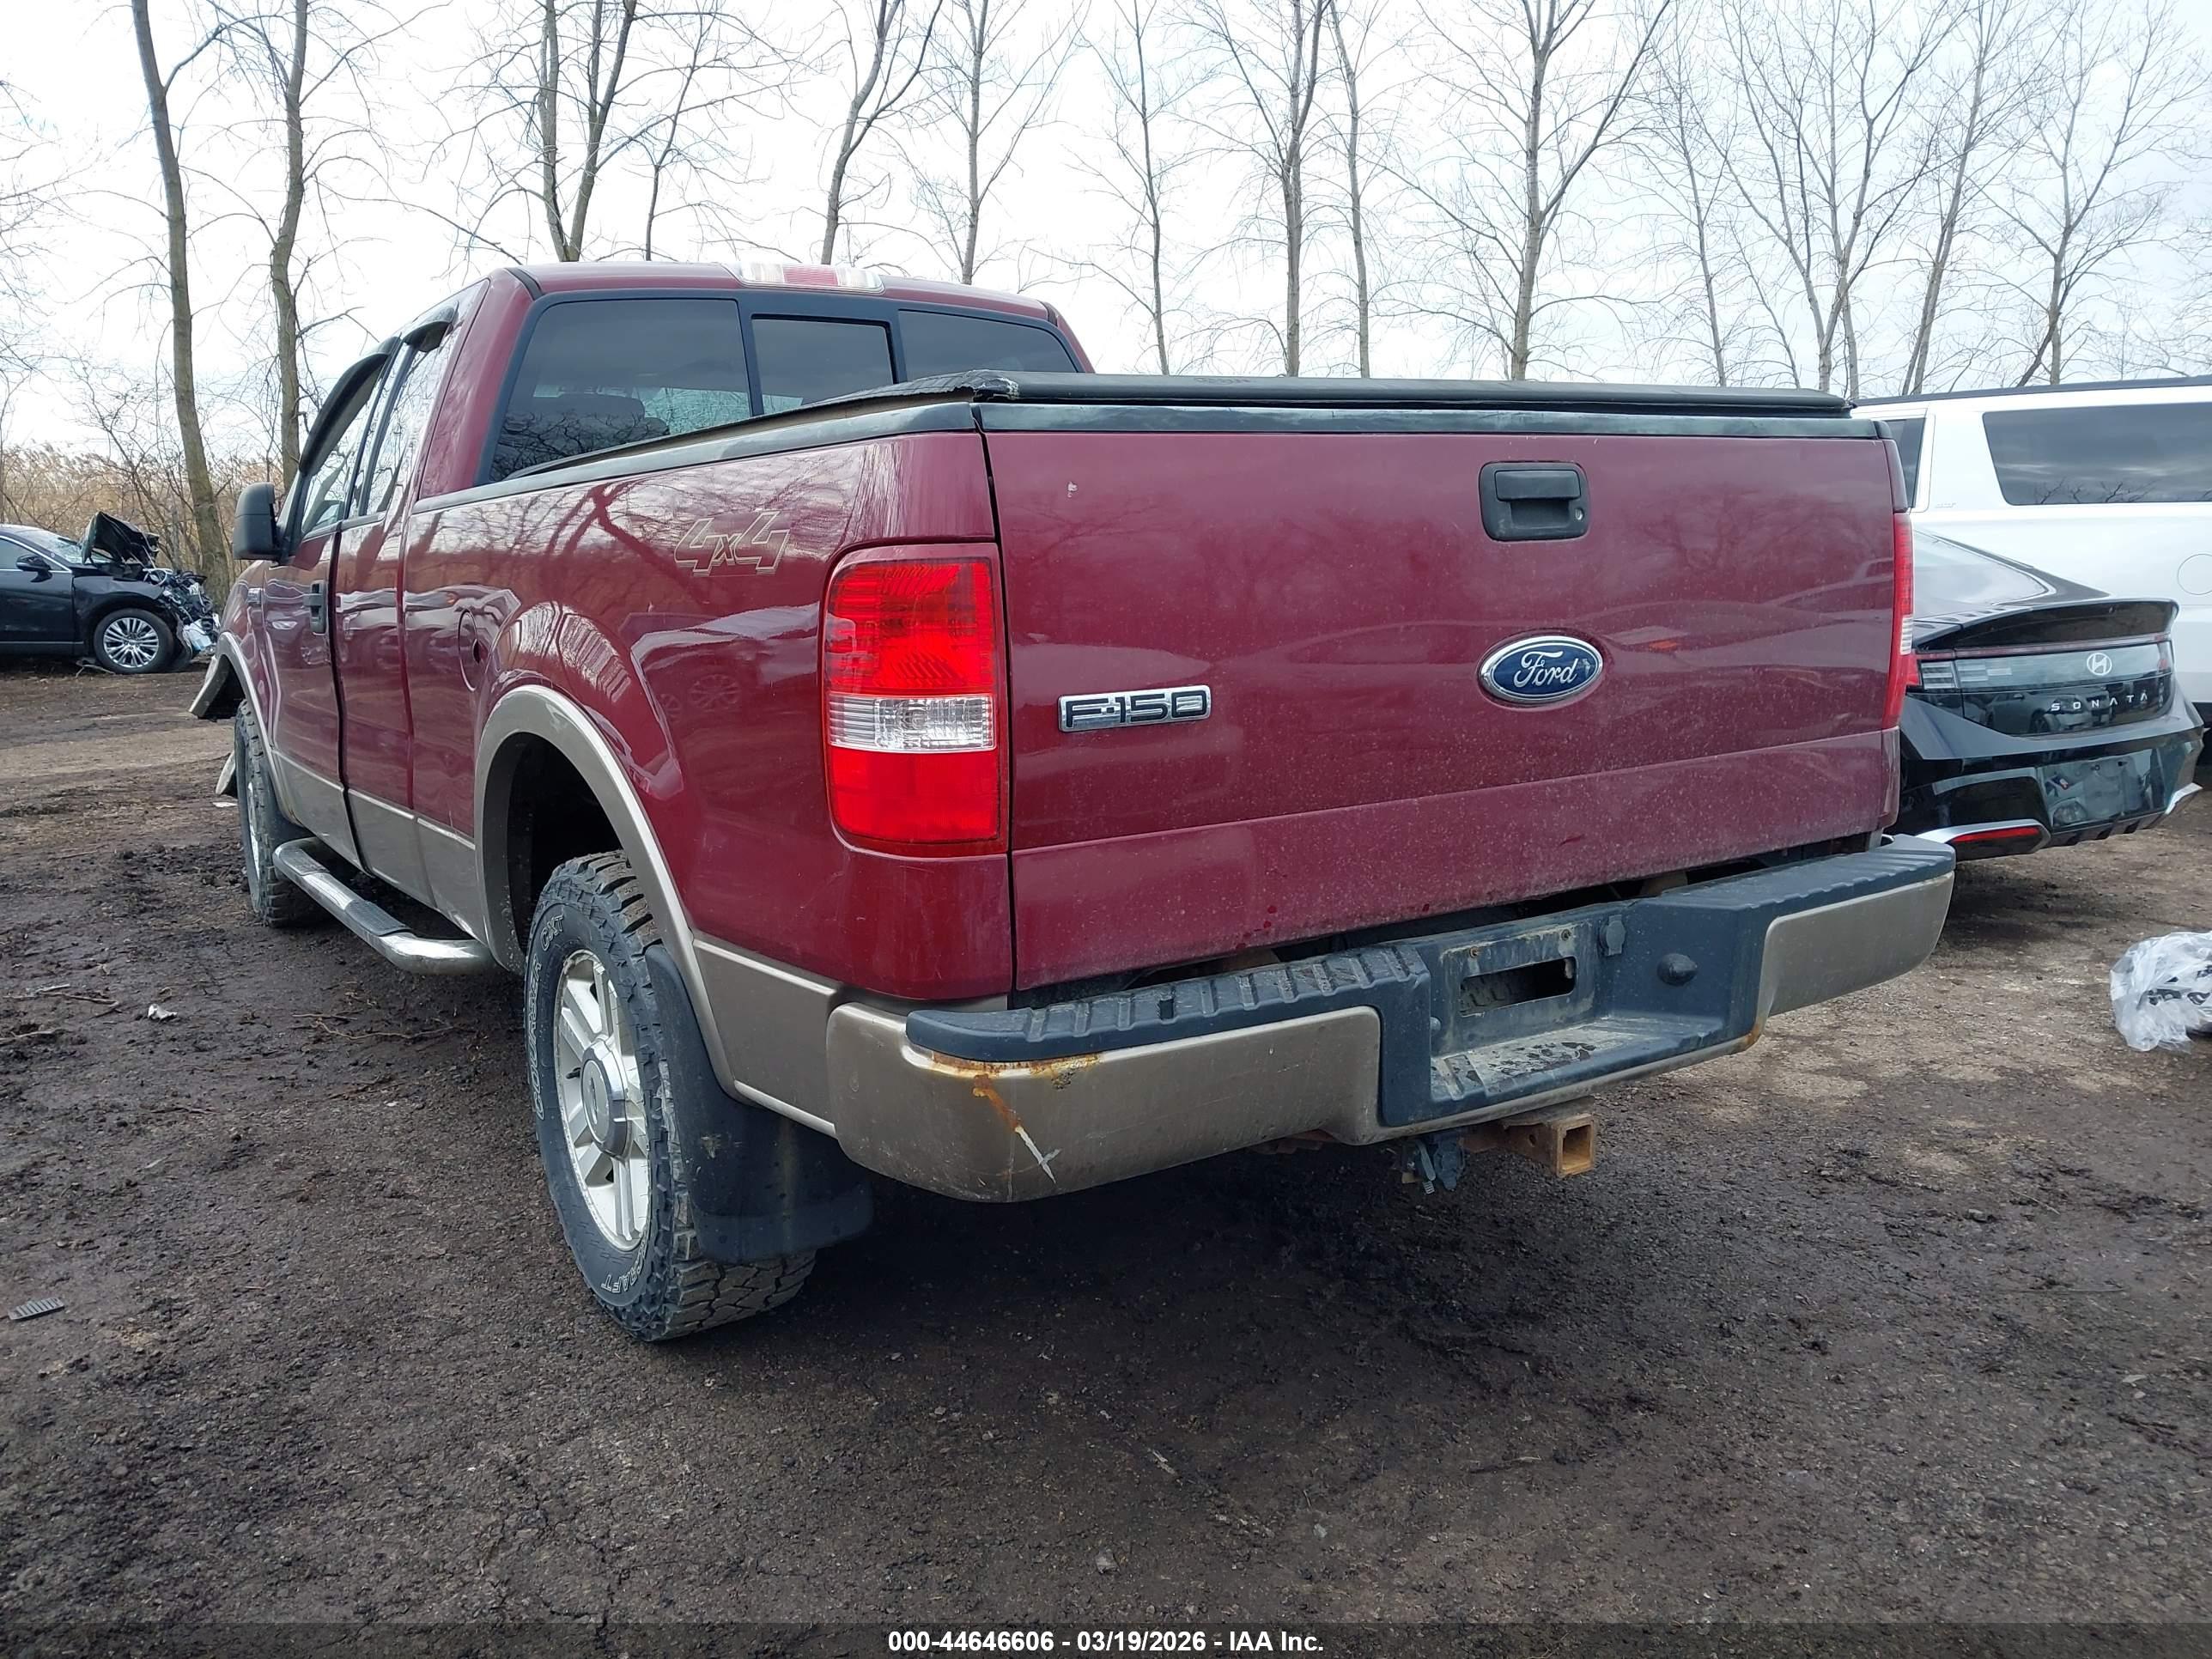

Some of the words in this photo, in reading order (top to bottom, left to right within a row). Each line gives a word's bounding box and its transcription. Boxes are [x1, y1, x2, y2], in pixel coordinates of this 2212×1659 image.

[674, 510, 791, 577] 4x4
[1513, 650, 1579, 687] Ford
[1064, 689, 1209, 729] F-150
[2051, 691, 2148, 711] SONATA
[527, 953, 544, 1121] COURSER
